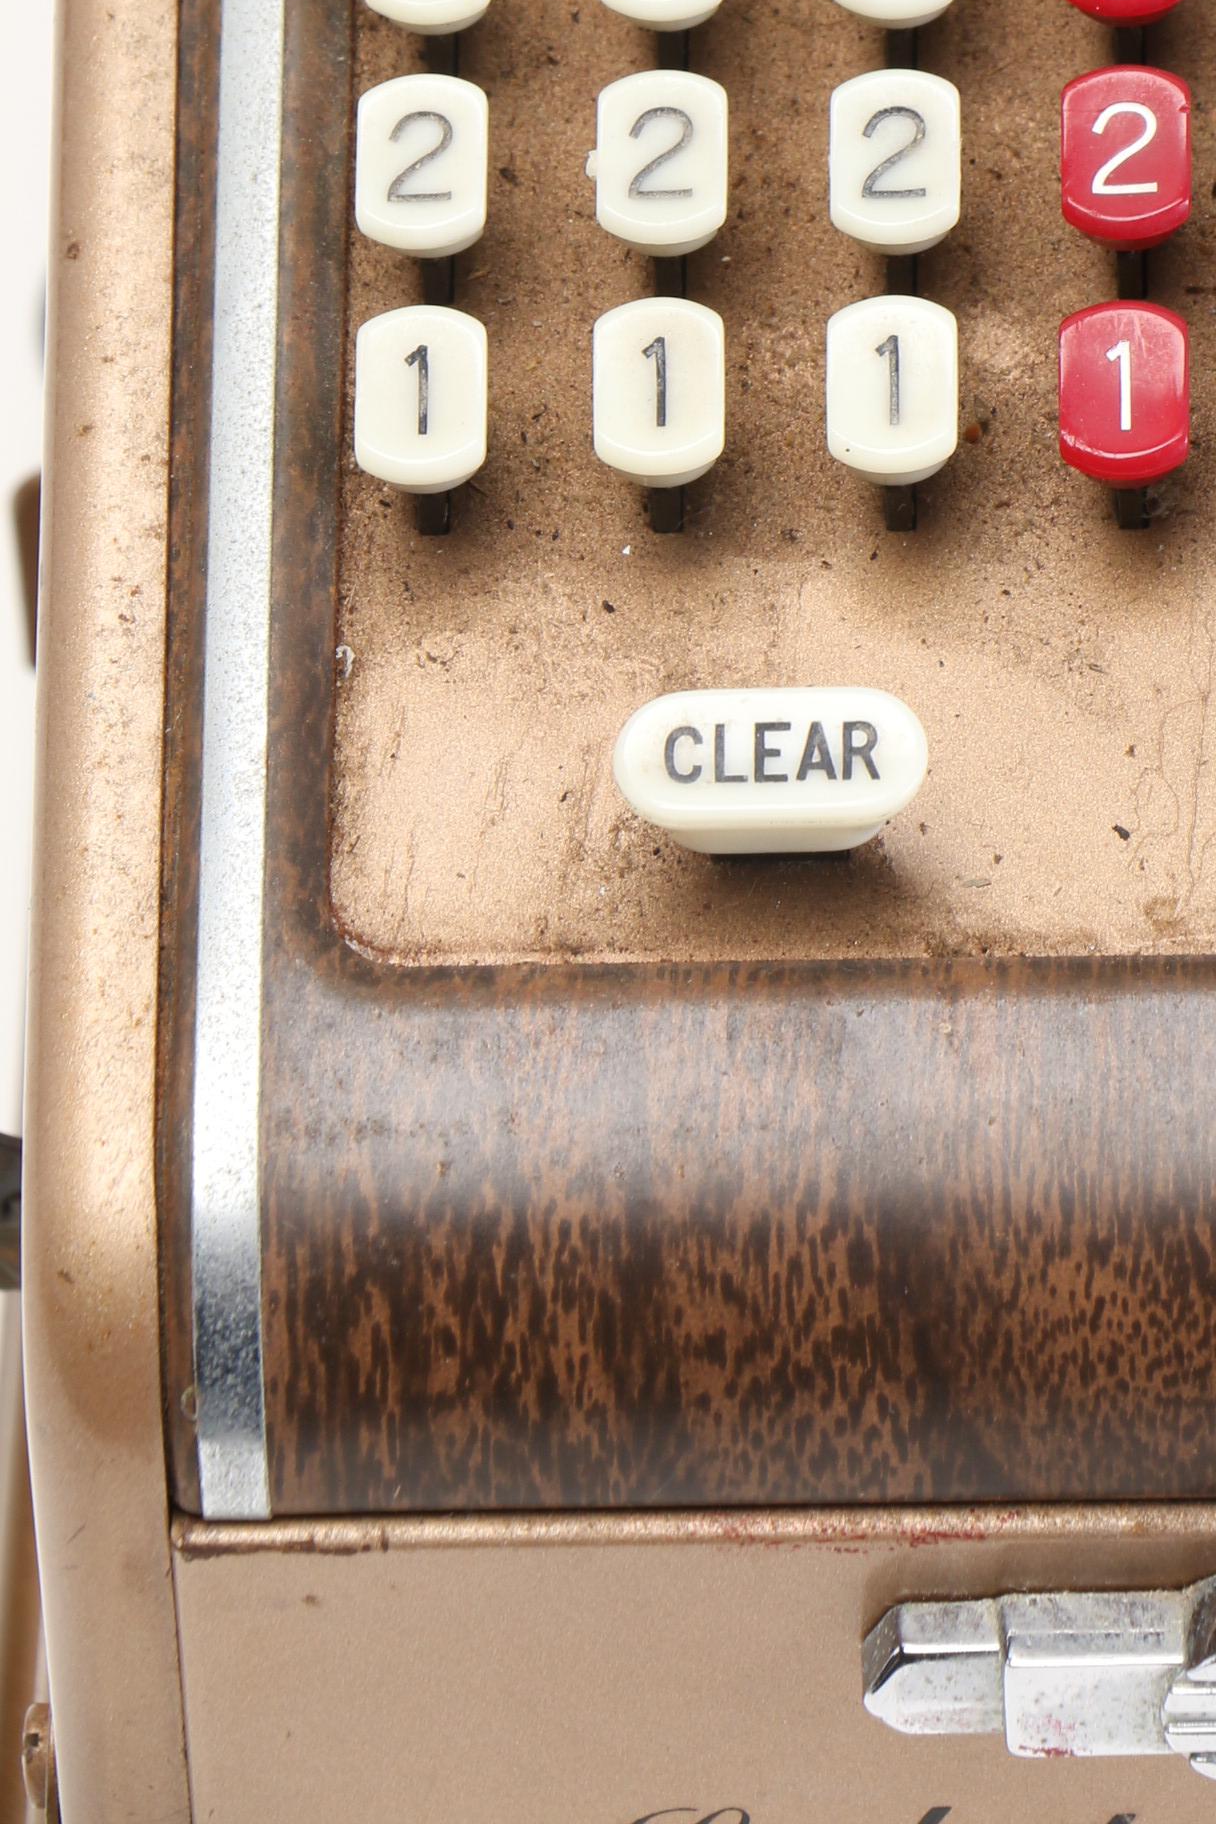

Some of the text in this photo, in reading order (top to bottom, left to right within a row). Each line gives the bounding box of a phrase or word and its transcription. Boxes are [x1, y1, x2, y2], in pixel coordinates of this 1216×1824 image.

[387, 110, 454, 203] 2
[628, 106, 695, 200] 2
[861, 105, 927, 200] 2
[1091, 102, 1158, 195] 2
[404, 345, 429, 435] 1
[641, 336, 667, 427] 1
[874, 334, 901, 426] 1
[1106, 340, 1132, 431] 1
[663, 720, 882, 784] CLEAR
